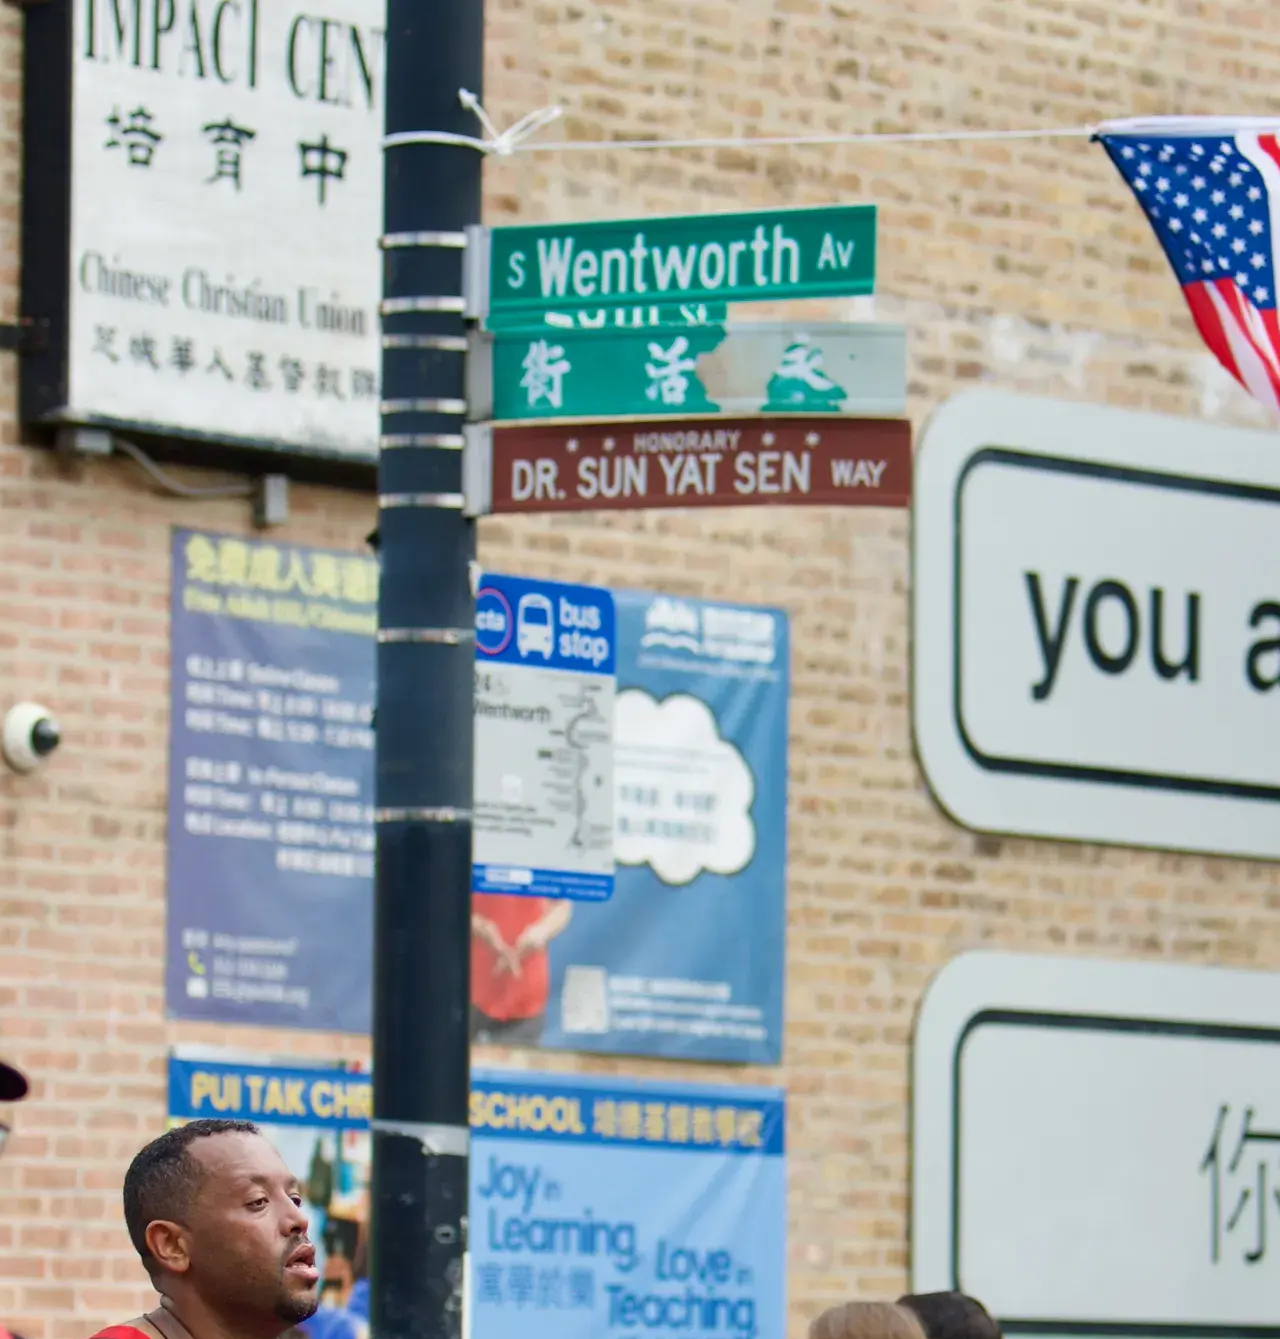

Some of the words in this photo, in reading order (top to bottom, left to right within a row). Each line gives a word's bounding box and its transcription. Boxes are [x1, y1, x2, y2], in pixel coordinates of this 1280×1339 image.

[84, 0, 260, 90] IMPACT
[287, 13, 382, 108] CEN
[508, 250, 526, 290] S
[536, 222, 800, 298] Wentworth
[79, 250, 172, 306] Chinese
[181, 264, 289, 326] Christian
[296, 284, 368, 338] Union
[633, 430, 743, 454] HONORARY
[511, 460, 567, 501] DR.
[576, 456, 649, 499] SUN
[656, 453, 723, 497] YAT
[733, 450, 812, 495] SEN
[830, 458, 888, 489] WAY
[559, 596, 601, 631] bus
[1025, 569, 1202, 702] you
[558, 630, 609, 668] stop
[191, 1071, 241, 1110] PUI
[245, 1074, 306, 1115] TAK
[469, 1090, 586, 1134] SCHOOL
[478, 1155, 541, 1214] Joy
[488, 1206, 639, 1272] Learning
[655, 1239, 734, 1285] Love
